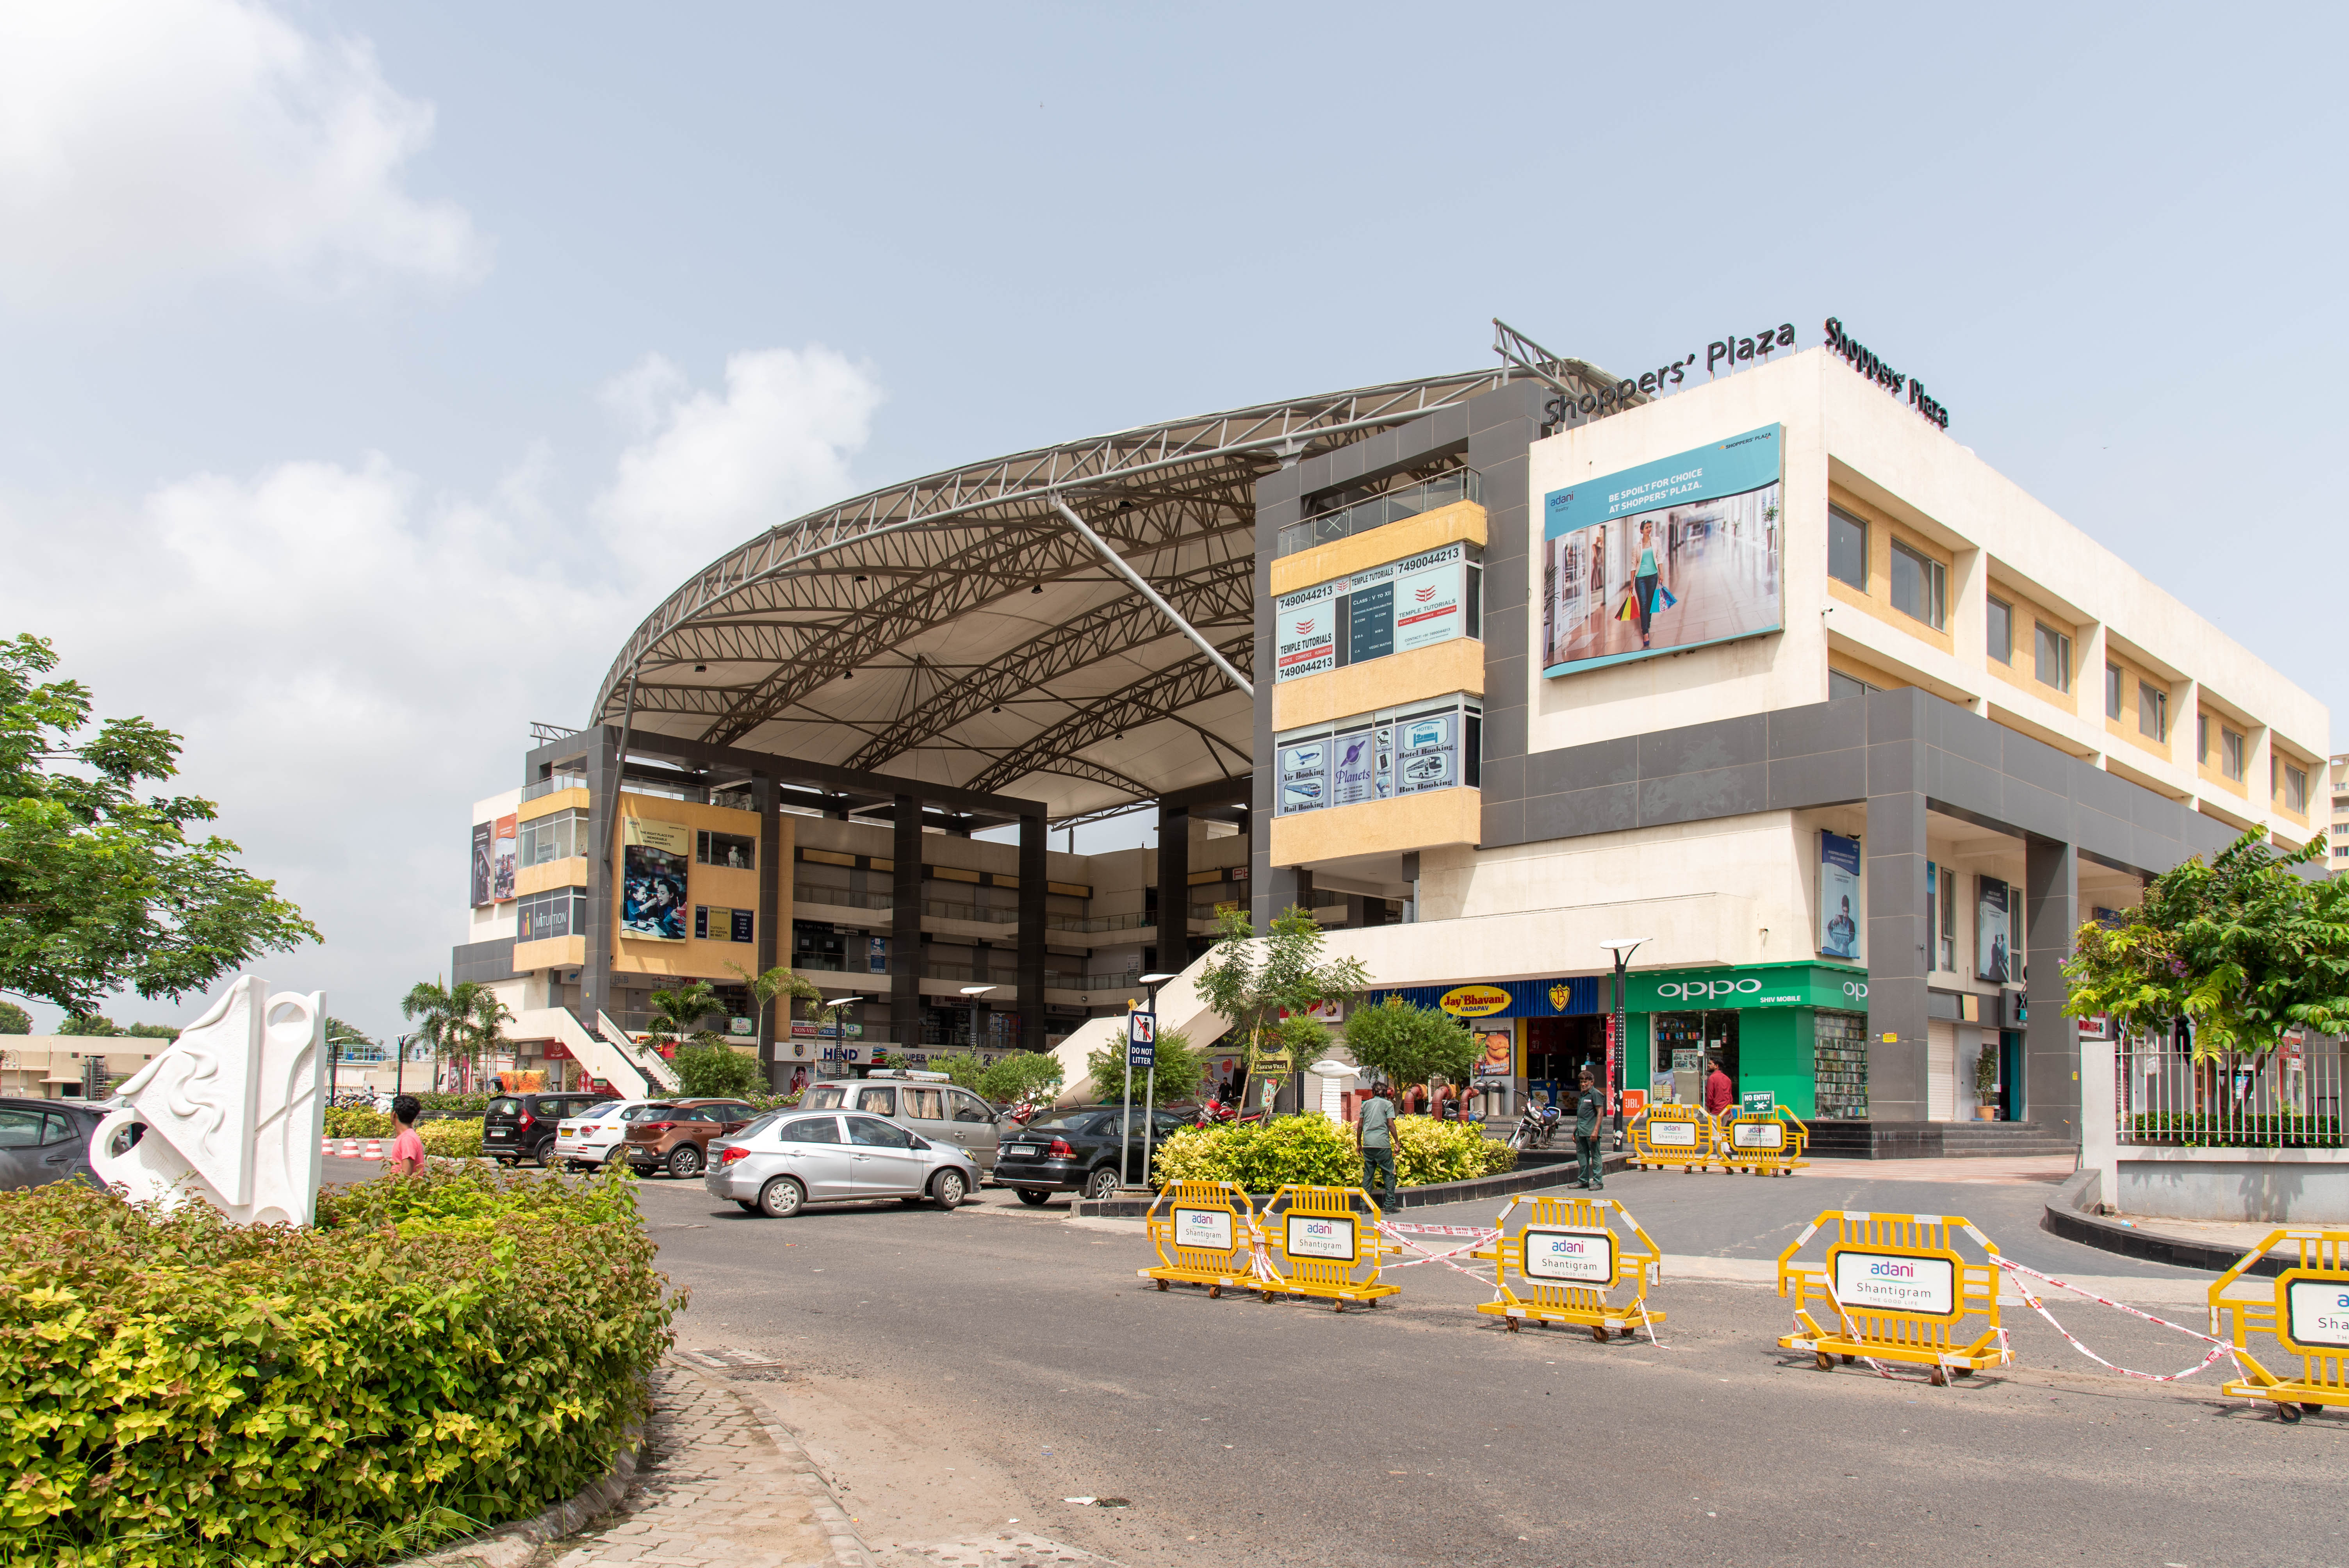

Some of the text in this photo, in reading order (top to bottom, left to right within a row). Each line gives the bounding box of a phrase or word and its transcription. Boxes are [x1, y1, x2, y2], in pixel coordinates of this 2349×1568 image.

[1707, 323, 1795, 372] Plaza
[1908, 378, 1949, 429] Plaza
[1755, 432, 1771, 441] PLAZA
[1609, 468, 1703, 502] BE SPOILT FOR CHOICE
[1551, 491, 1574, 507] adani
[1609, 505, 1620, 514] AT
[1670, 481, 1702, 496] PLAZA.
[1398, 547, 1459, 574] 7490044213
[1352, 568, 1393, 586] TEMPLE TUTORIALS
[1280, 586, 1332, 609] 7490044213
[1399, 599, 1456, 618] TEMPLE TUTORIALS
[1281, 633, 1331, 655] TEMPLE TUTORIALS
[1296, 652, 1312, 660] COMMERCE
[1315, 647, 1332, 655] HUMANITIES
[1280, 657, 1332, 679] 7490044213
[1399, 744, 1453, 759] Hotel Booking
[1283, 768, 1324, 782] Air Booking
[1336, 769, 1370, 784] Planets
[1417, 779, 1453, 790] Booking
[1298, 801, 1324, 811] Booking
[1444, 994, 1505, 1008] Jay Bhavani
[1132, 1056, 1151, 1065] LITTER
[1625, 1098, 1640, 1108] JBL
[1192, 1213, 1214, 1224] adani
[1186, 1228, 1221, 1240] Shantigram
[1307, 1223, 1332, 1235] adani
[1299, 1239, 1342, 1251] Shantigram
[1552, 1240, 1584, 1253] adani
[1542, 1258, 1597, 1271] Shantigram
[1871, 1261, 1914, 1277] adani
[1857, 1283, 1931, 1298] Shantigram
